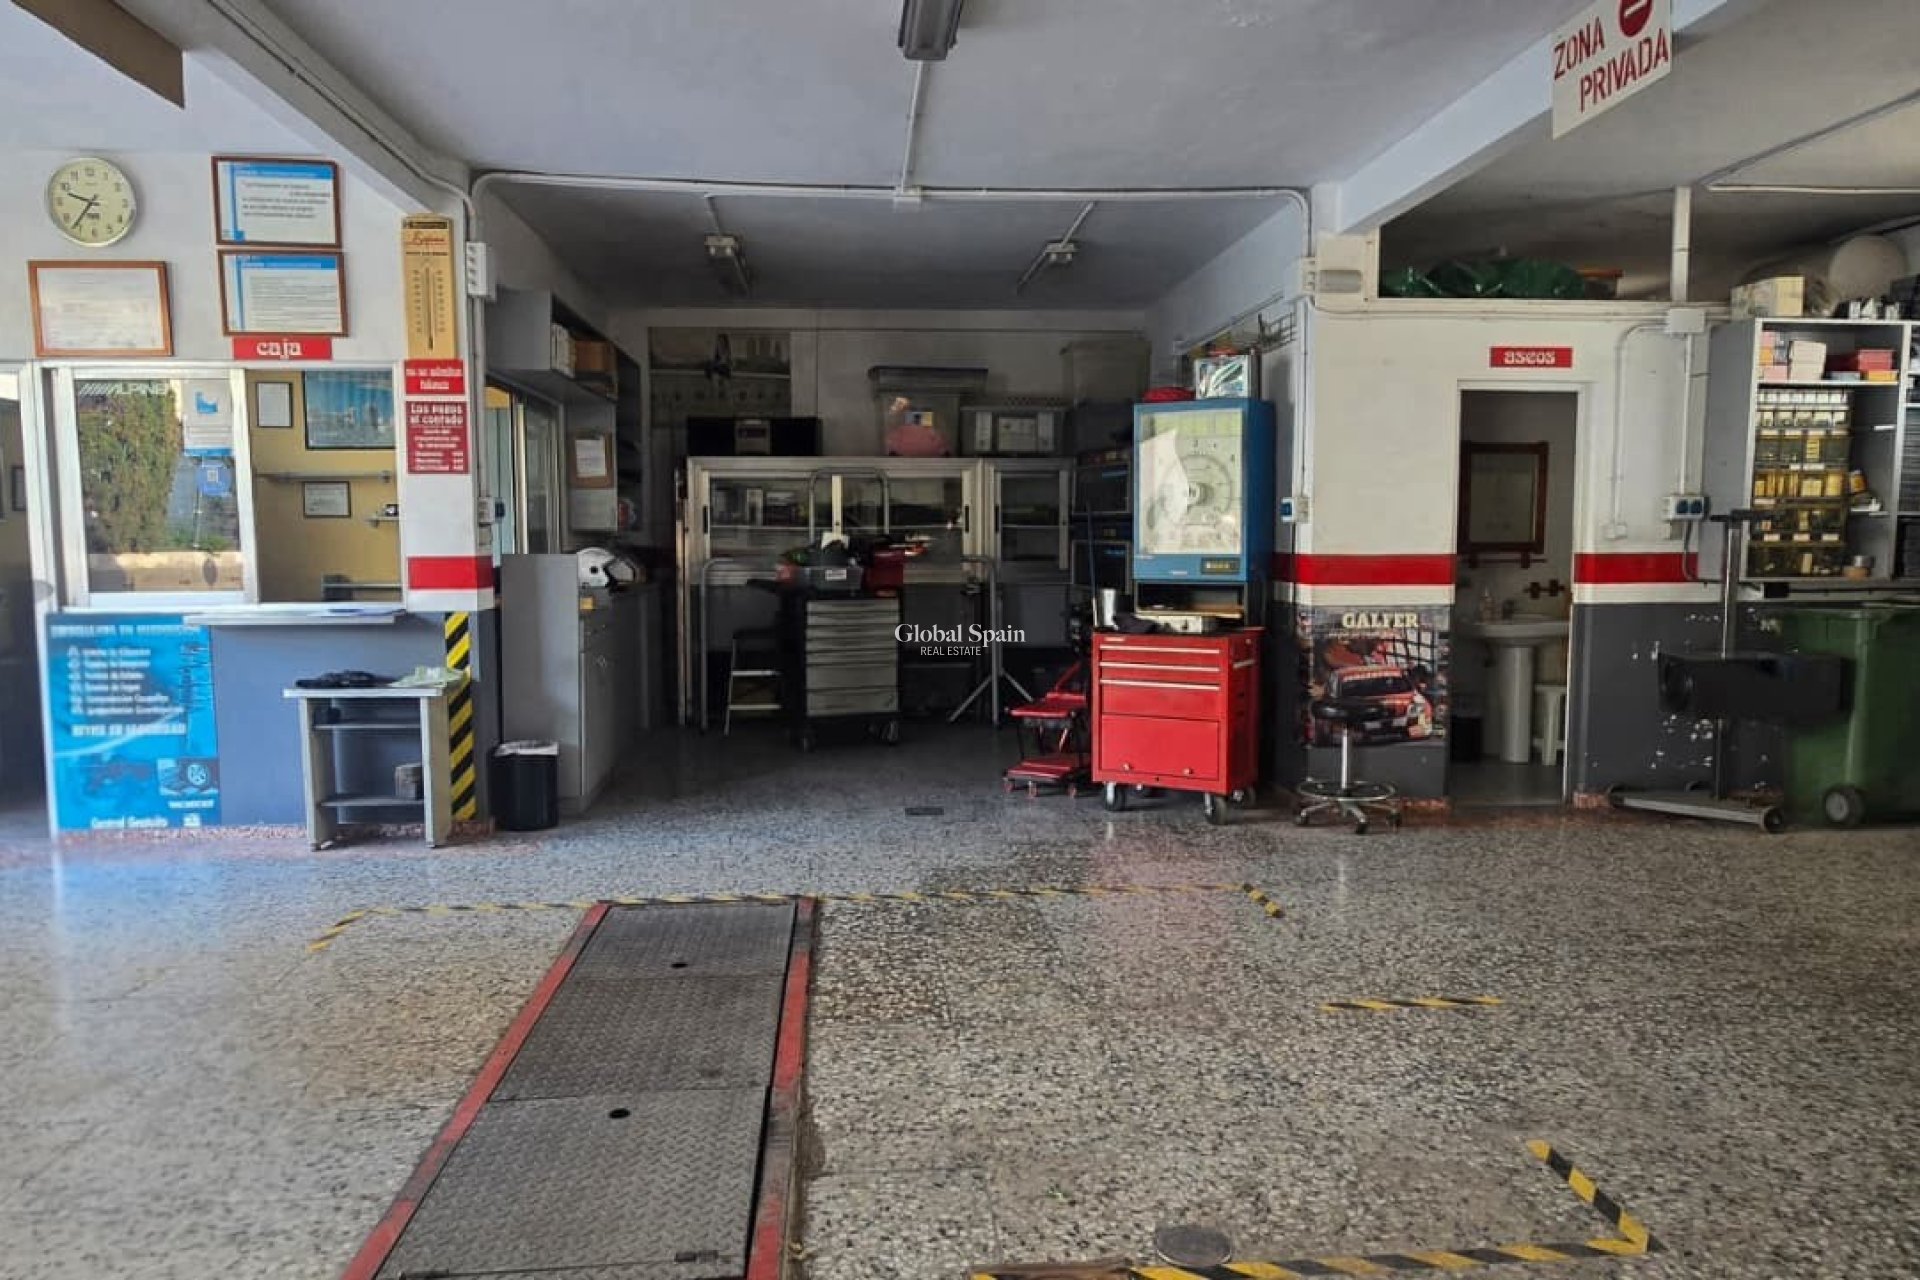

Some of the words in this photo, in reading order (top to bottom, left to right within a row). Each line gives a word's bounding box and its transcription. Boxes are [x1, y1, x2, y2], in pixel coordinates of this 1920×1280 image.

[1554, 16, 1605, 81] ZONA
[1581, 27, 1669, 114] PRIVADA
[256, 339, 303, 360] caja
[1503, 350, 1556, 365] aseos
[1342, 611, 1419, 628] GALFER
